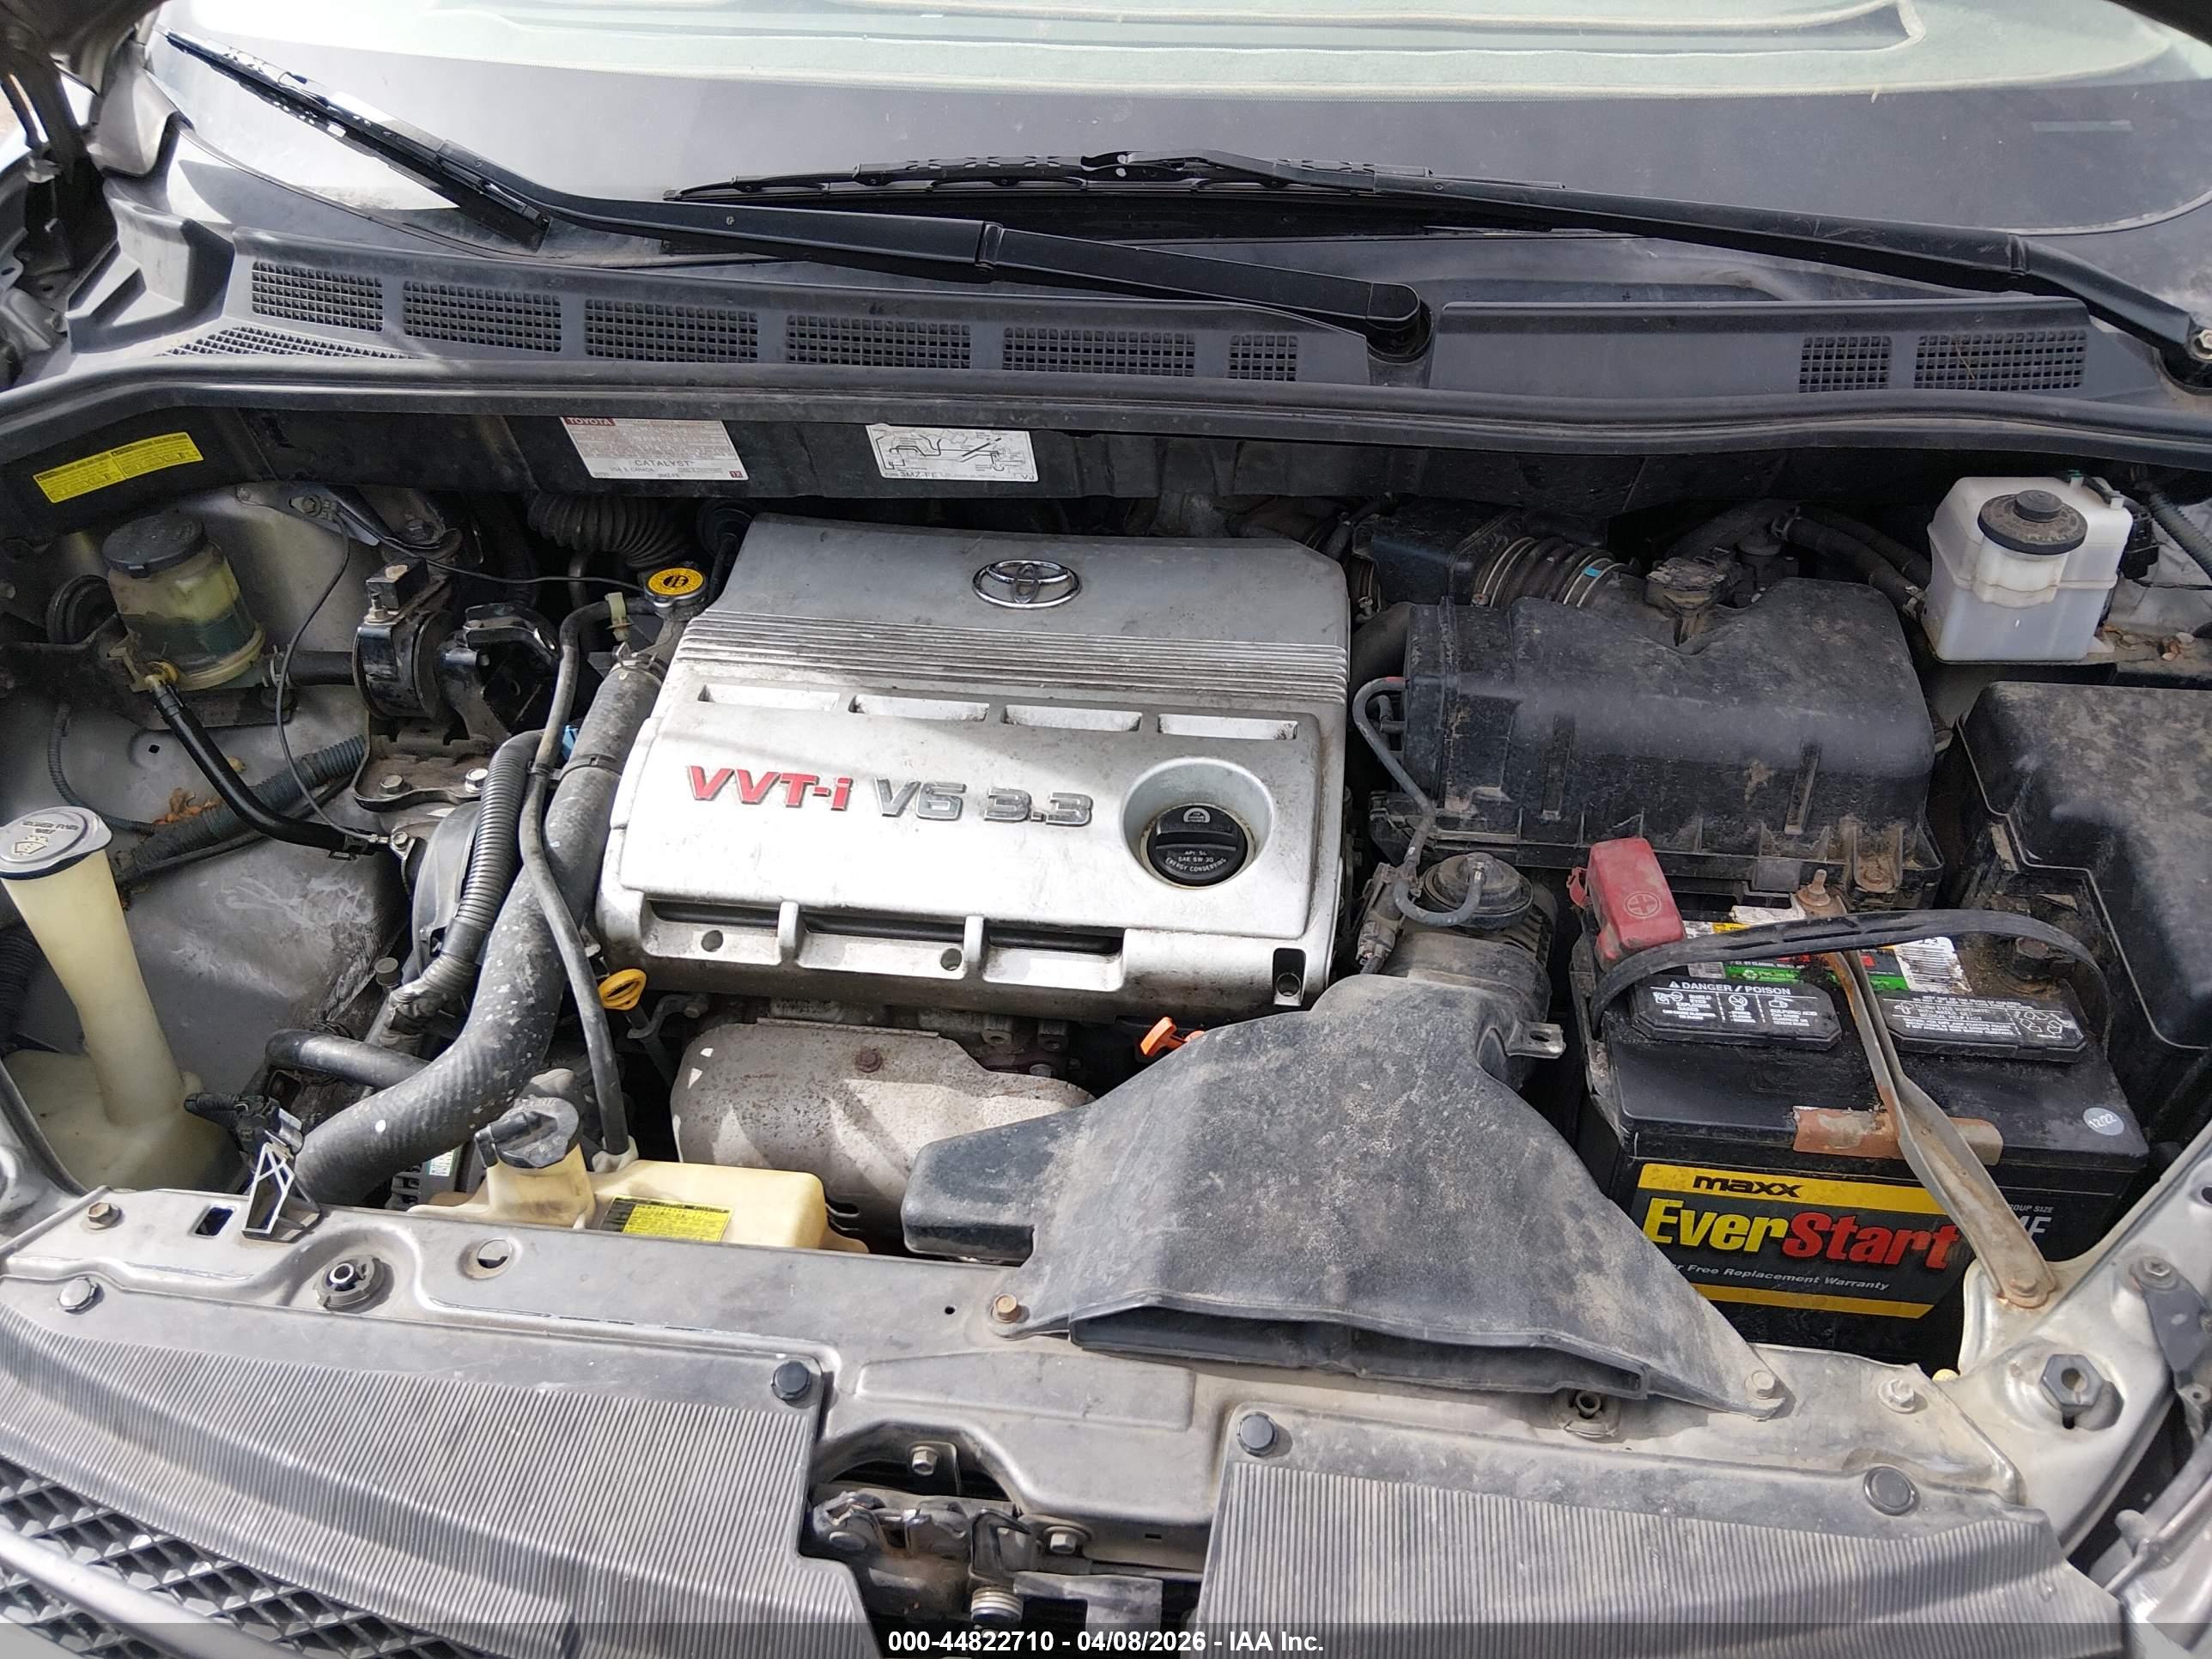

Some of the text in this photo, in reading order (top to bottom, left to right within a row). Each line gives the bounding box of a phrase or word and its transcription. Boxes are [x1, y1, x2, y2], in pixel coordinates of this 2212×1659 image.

[567, 416, 613, 425] TOYOTA
[687, 764, 1094, 827] VVT-i V6 3.3
[1164, 857, 1227, 872] ENERGY CONSERVING
[1681, 981, 1733, 993] DANGER
[1744, 985, 1791, 995] POISON
[2087, 1113, 2118, 1128] 12/22
[1692, 1175, 1805, 1199] maxx
[2033, 1205, 2054, 1213] SIZE
[1642, 1196, 1961, 1271] EverStart
[1686, 1264, 1719, 1274] Free
[1723, 1267, 1821, 1285] Replacement
[1824, 1277, 1890, 1291] Warranty
